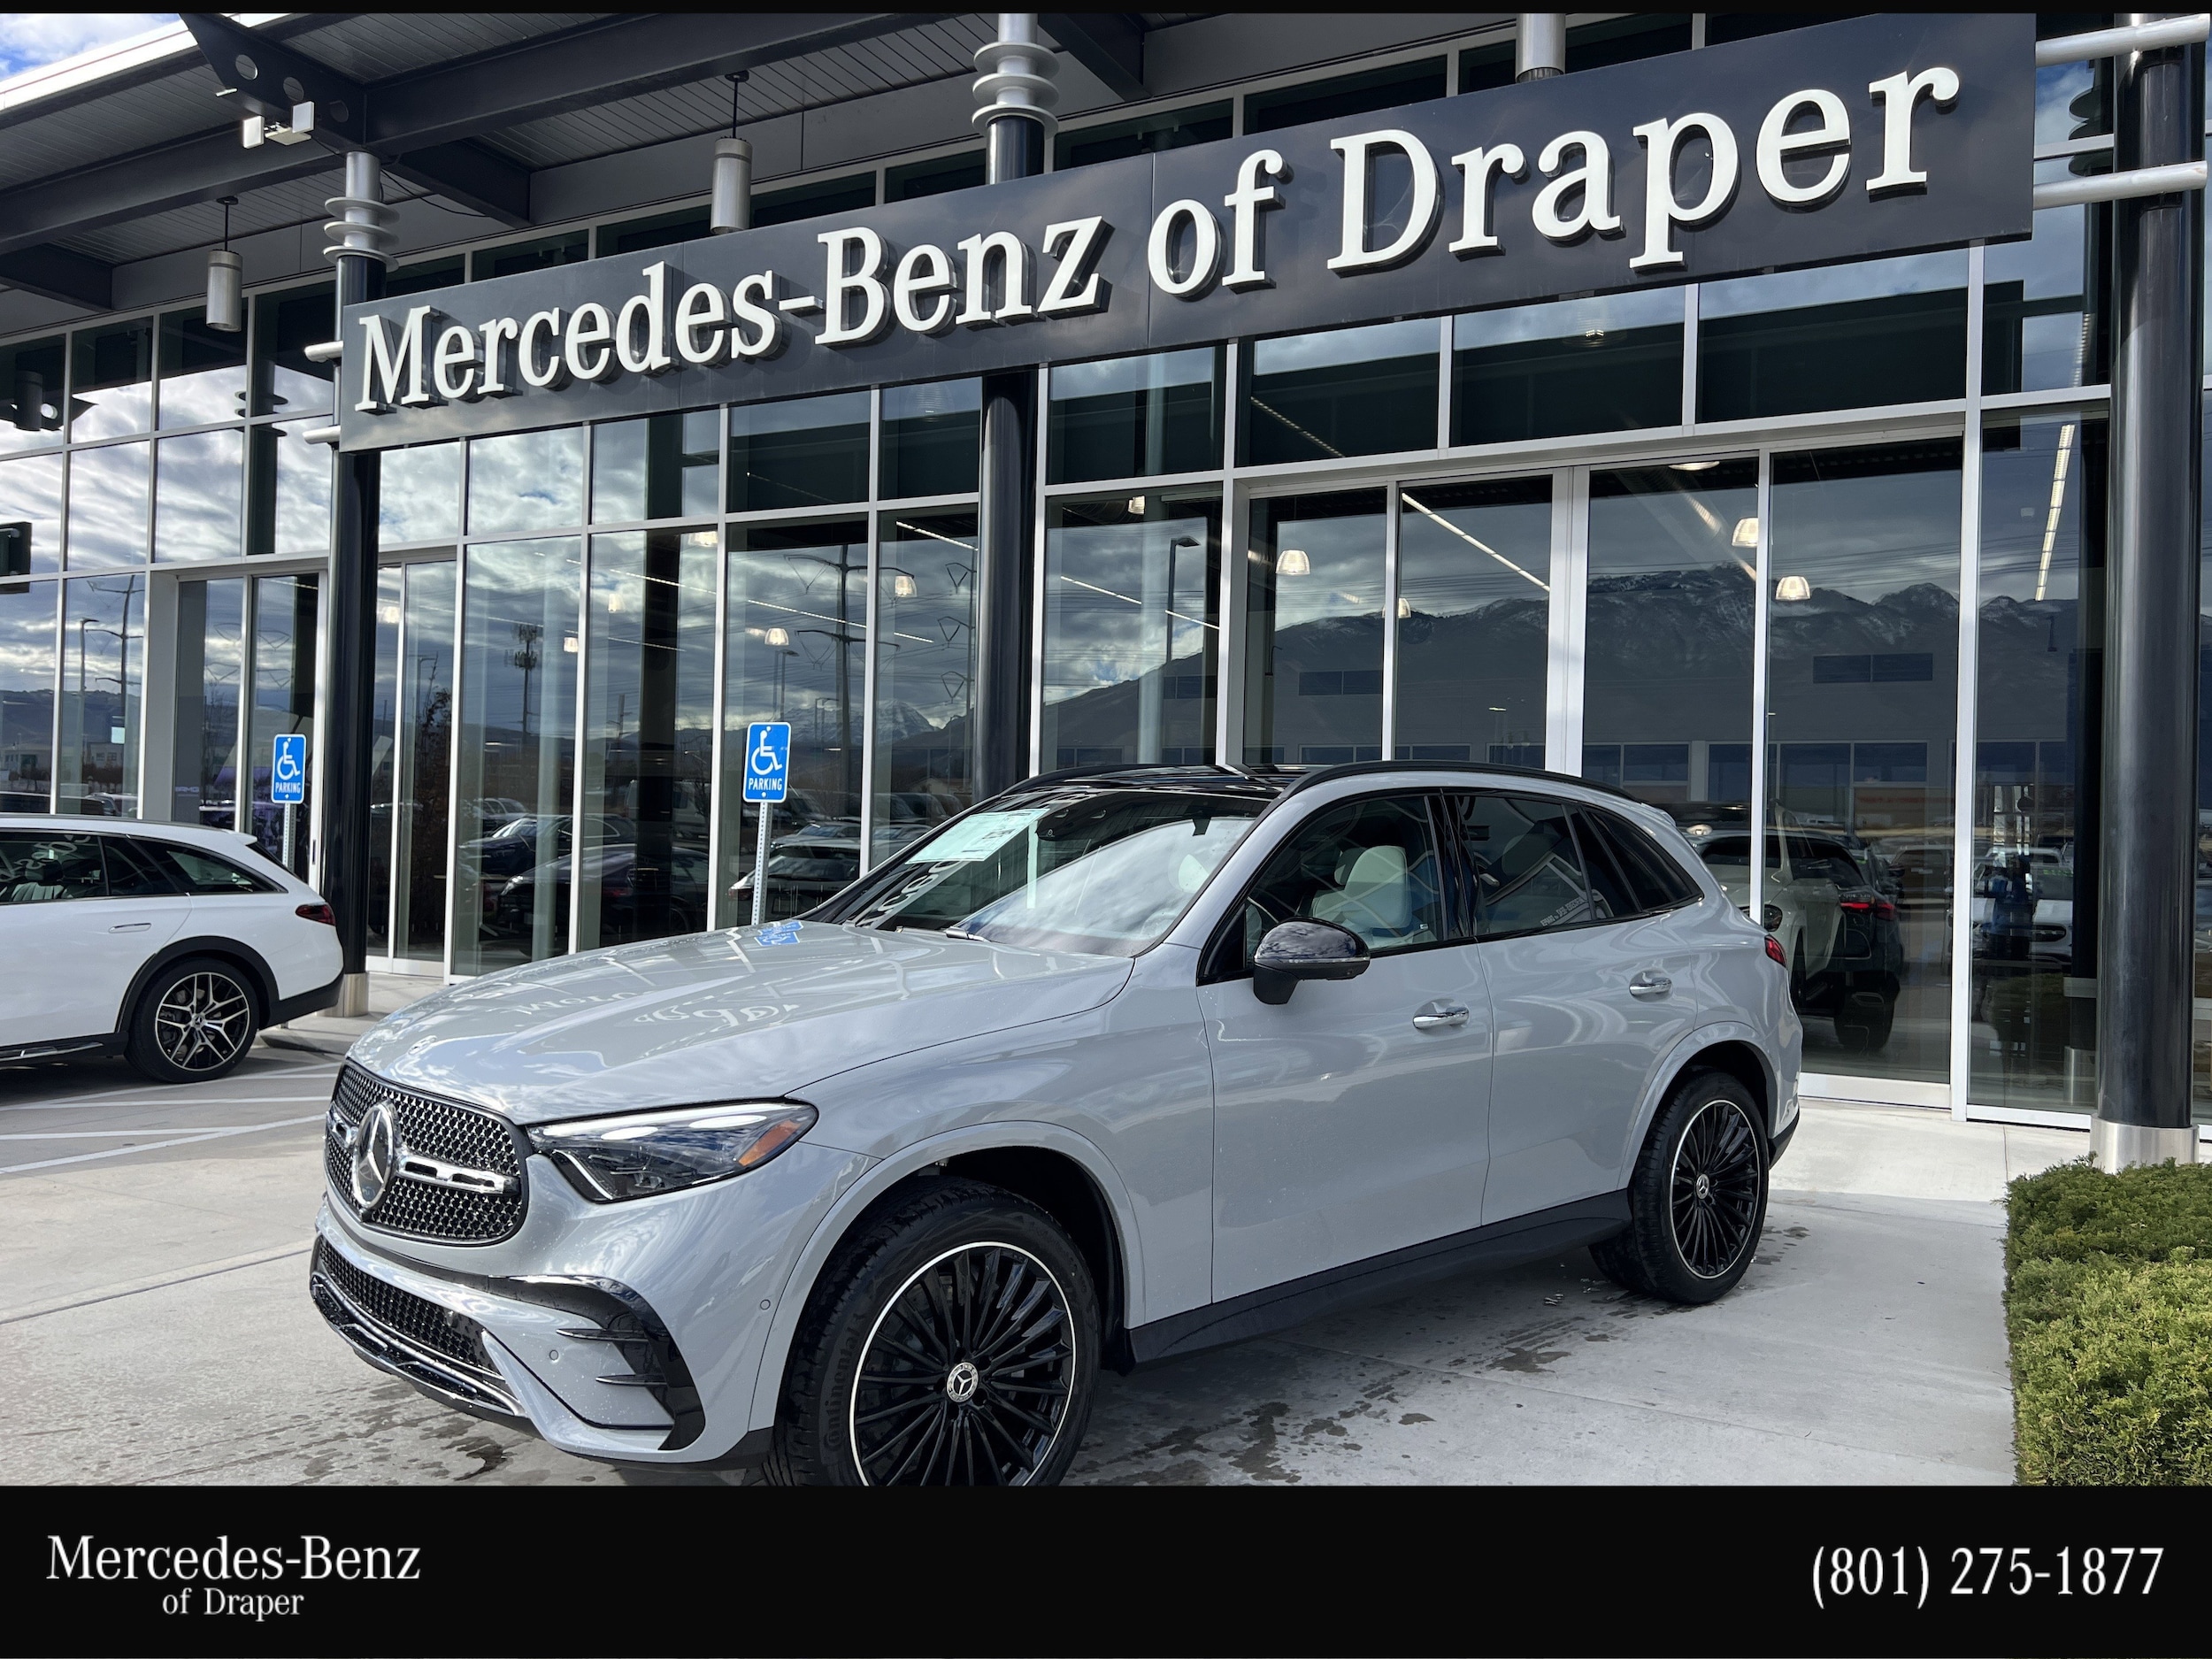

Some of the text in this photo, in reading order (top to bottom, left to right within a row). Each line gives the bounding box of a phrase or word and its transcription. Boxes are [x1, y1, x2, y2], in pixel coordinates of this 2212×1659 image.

[353, 66, 1962, 413] Mercedes-Benz of Draper
[274, 781, 302, 794] PARKING
[748, 777, 783, 792] PARKING
